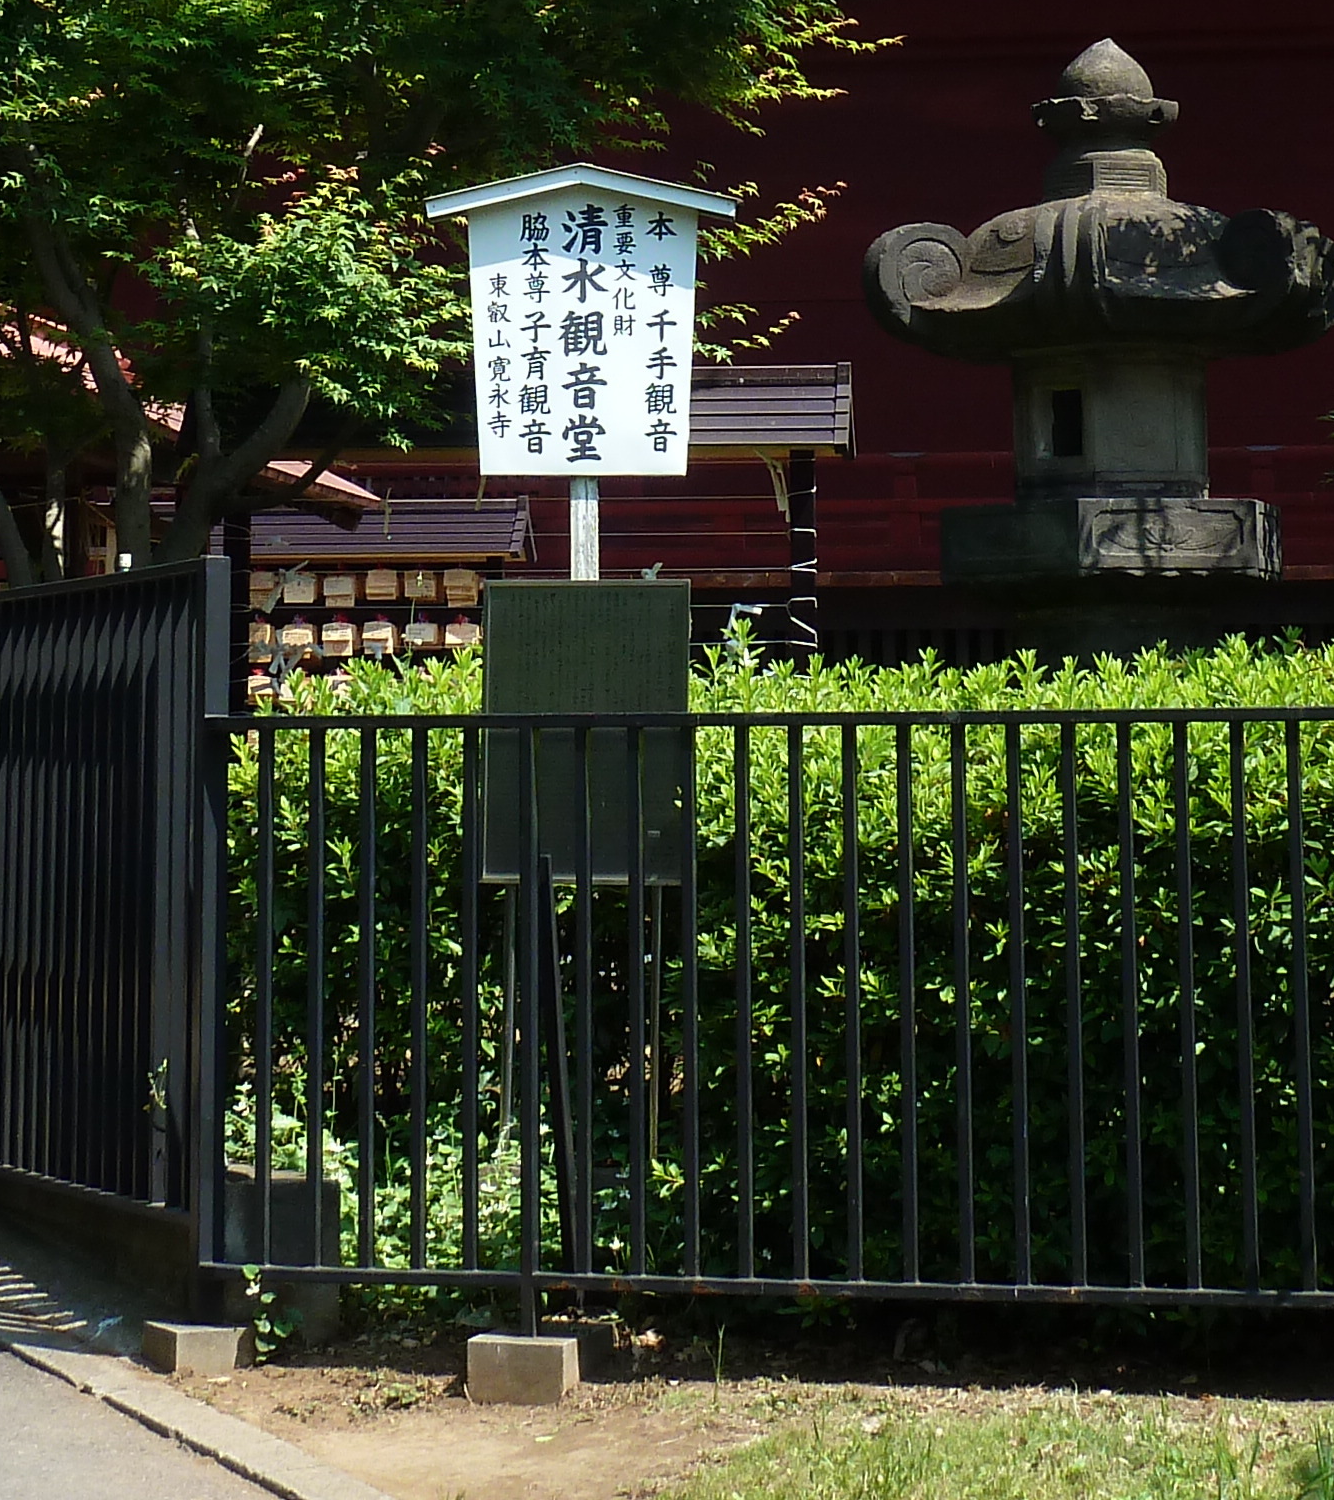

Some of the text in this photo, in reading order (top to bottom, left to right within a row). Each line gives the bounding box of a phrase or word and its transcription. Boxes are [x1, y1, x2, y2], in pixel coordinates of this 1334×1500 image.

[518, 212, 552, 455] 脇本尊子育観音
[558, 203, 609, 463] 清水観音堂
[612, 203, 637, 337] 重要文化財
[644, 211, 678, 453] 本尊千手観音
